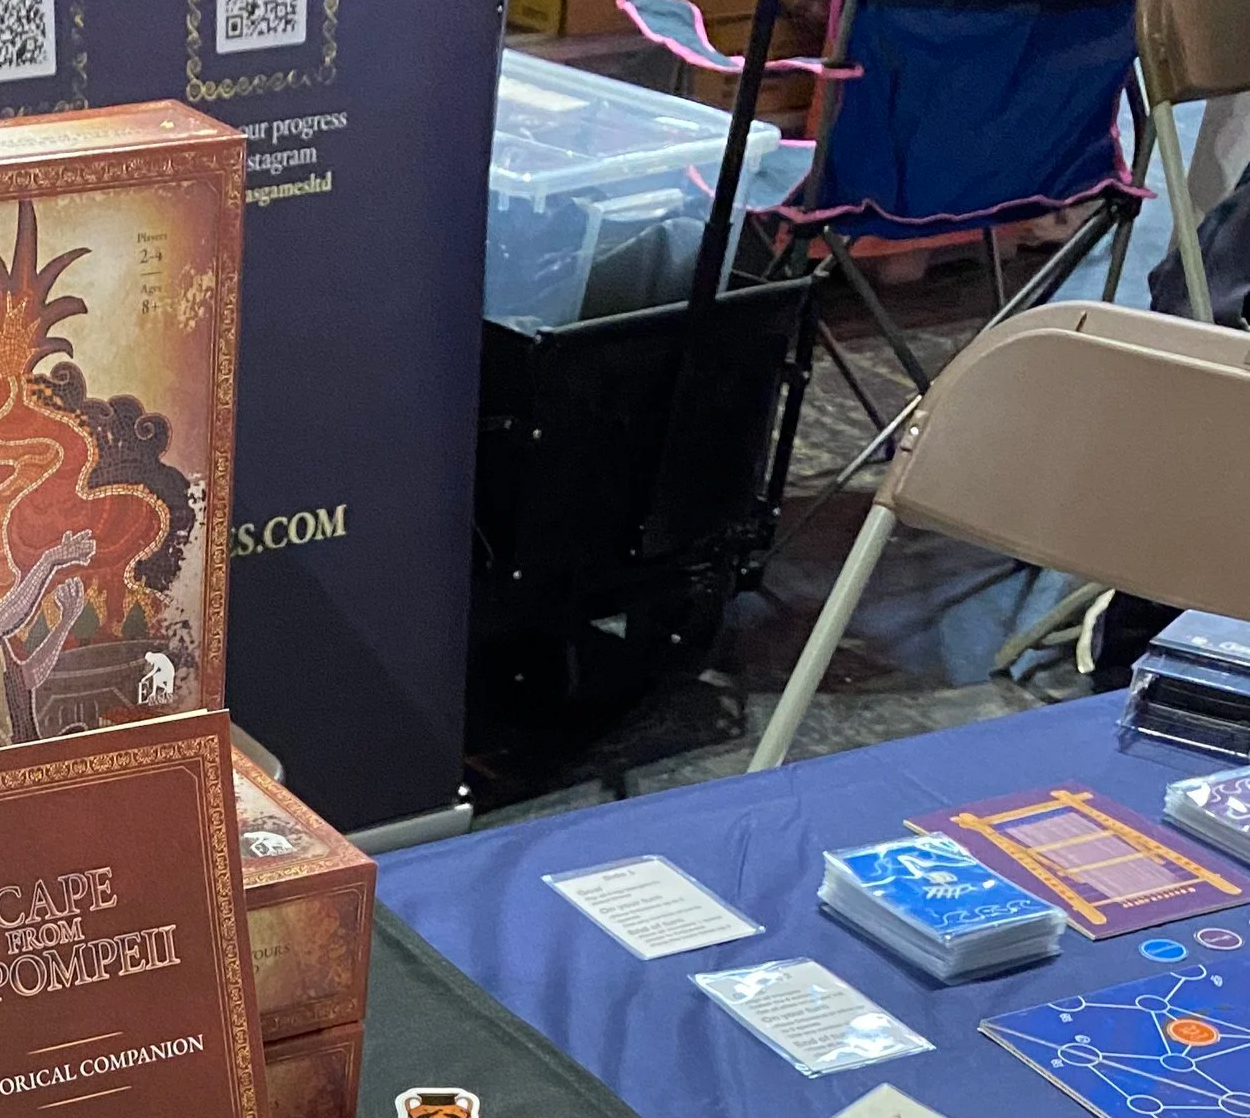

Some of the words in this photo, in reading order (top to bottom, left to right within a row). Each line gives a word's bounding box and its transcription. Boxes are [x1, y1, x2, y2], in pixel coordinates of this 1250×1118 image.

[272, 111, 348, 145] progress
[248, 147, 317, 175] stagram
[245, 171, 332, 206] sgamesltd
[6, 916, 84, 956] FROM
[251, 945, 291, 961] OURS
[79, 1034, 205, 1080] COMPANION
